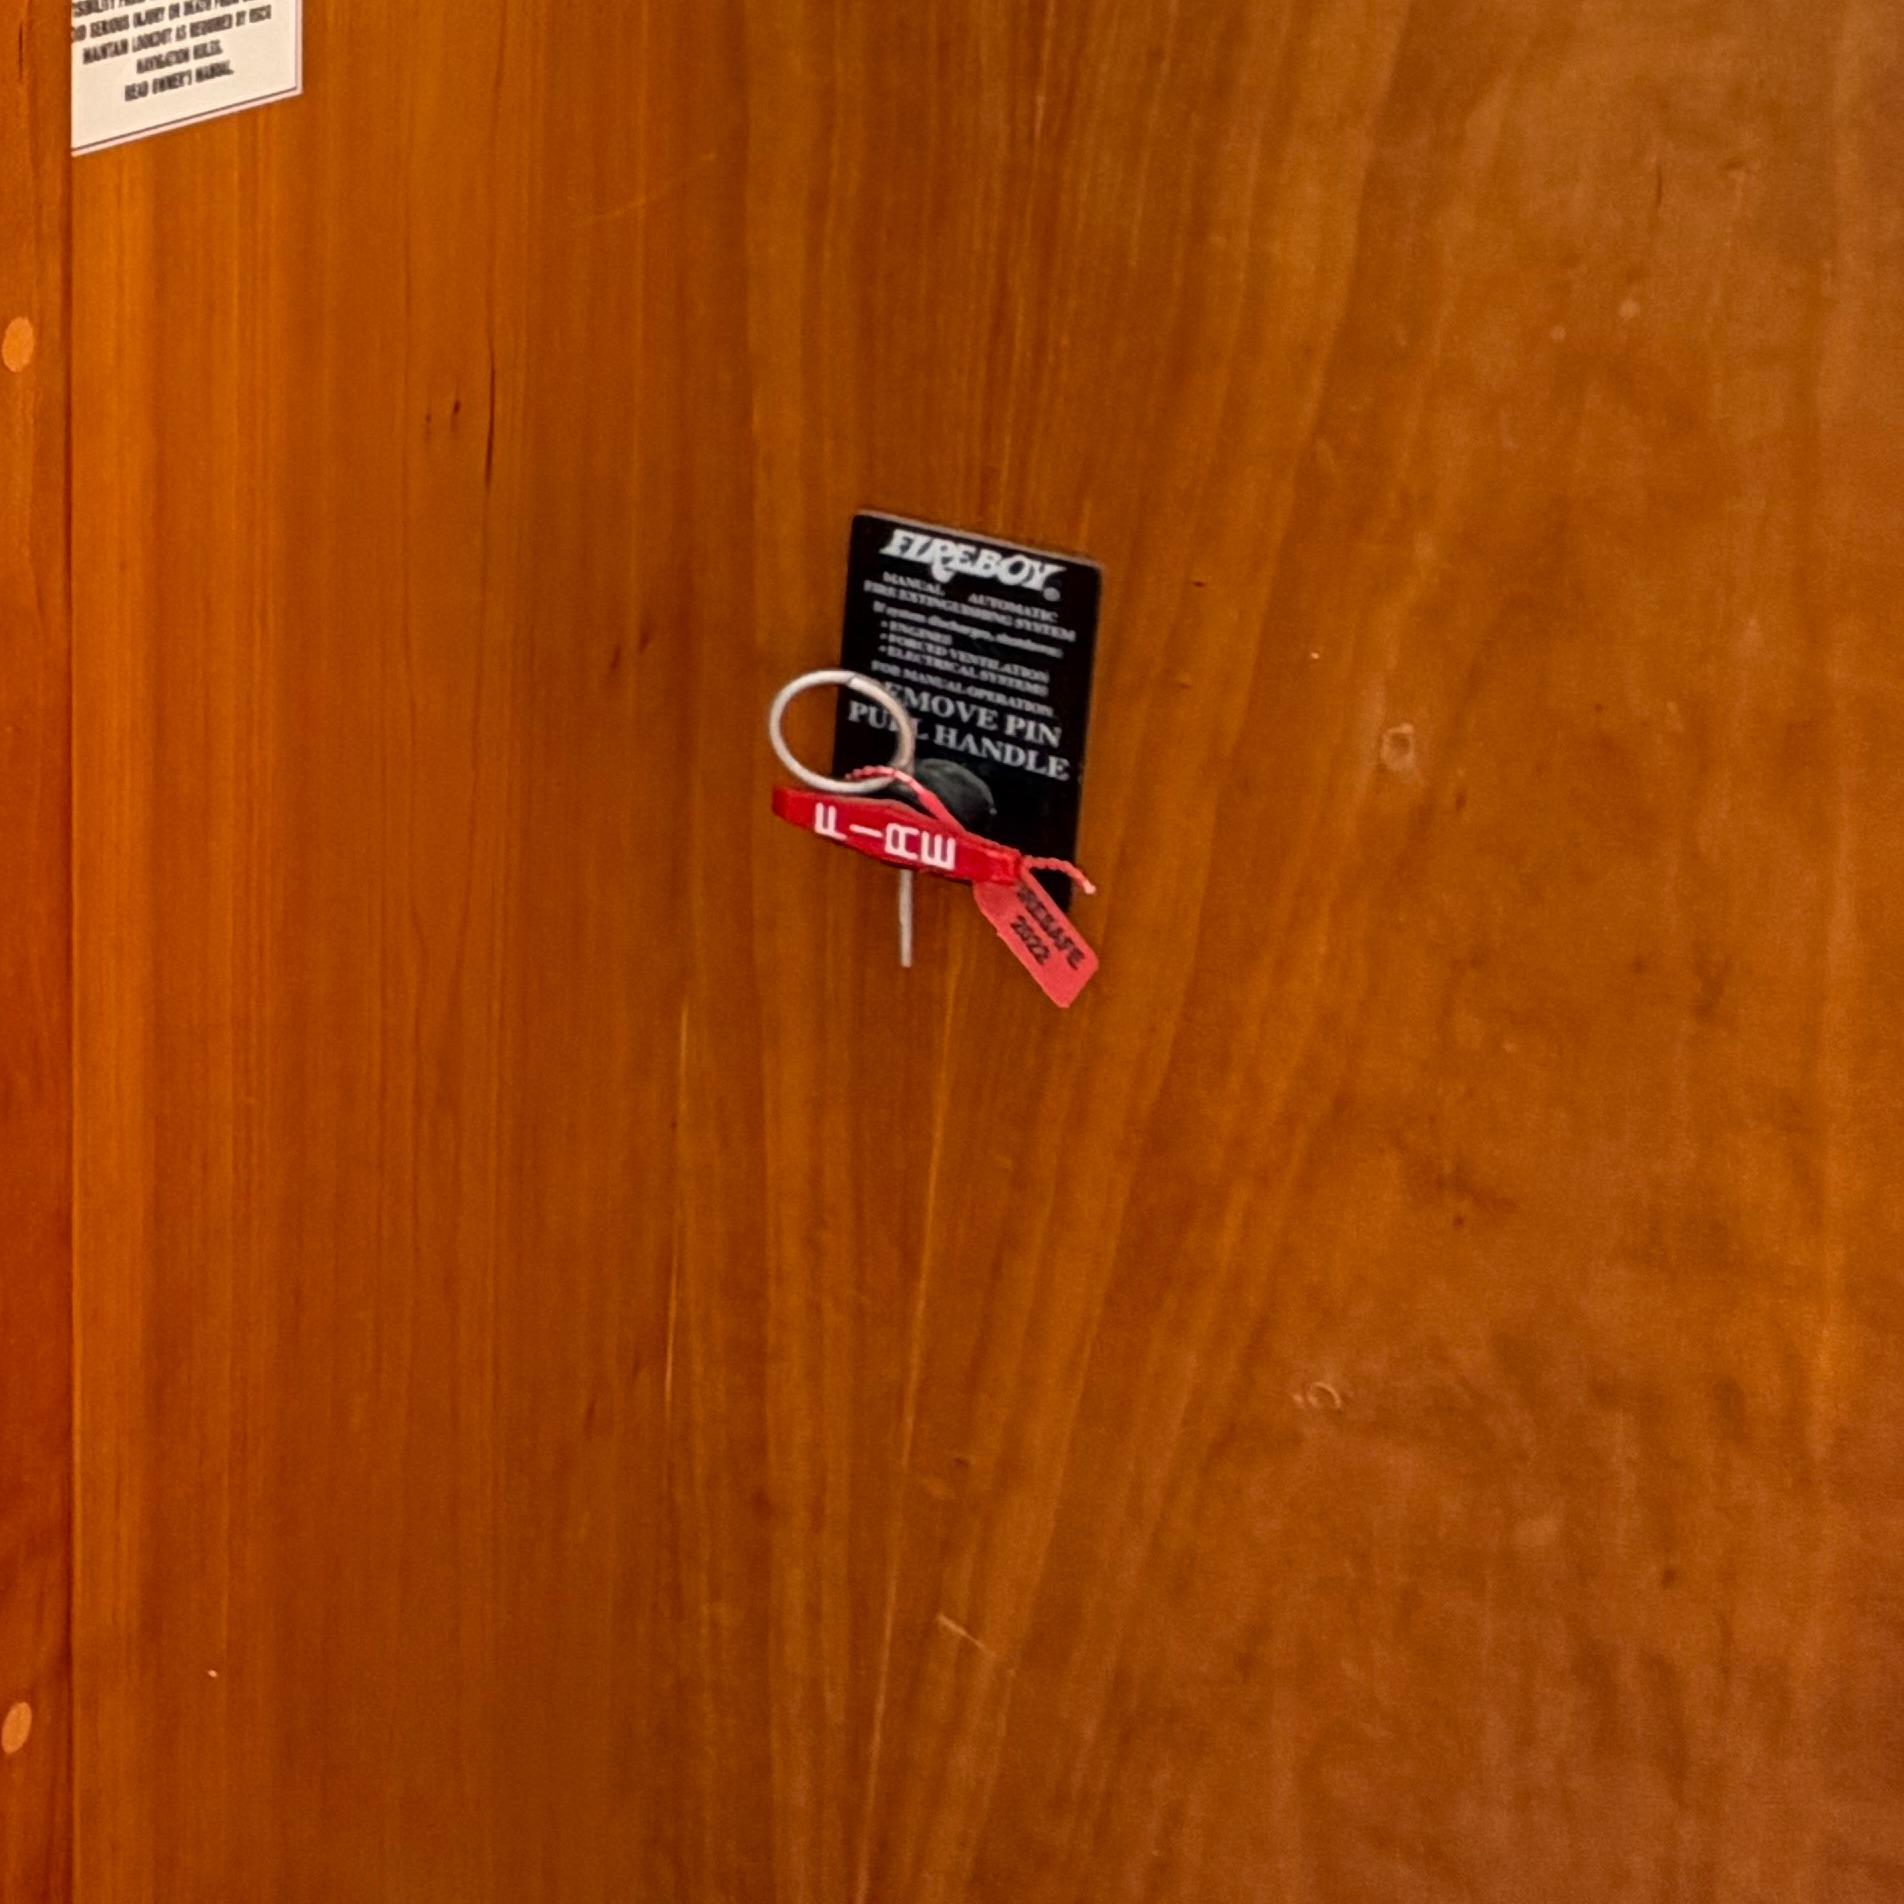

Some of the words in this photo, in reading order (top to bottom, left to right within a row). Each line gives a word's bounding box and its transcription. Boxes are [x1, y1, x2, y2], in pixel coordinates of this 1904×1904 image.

[878, 528, 1067, 592] FIREBOY
[877, 679, 999, 731] EMOVE
[1005, 714, 1063, 748] PIN
[934, 724, 1072, 781] HANDLE
[814, 802, 956, 871] FIRE
[1010, 915, 1050, 966] 2022
